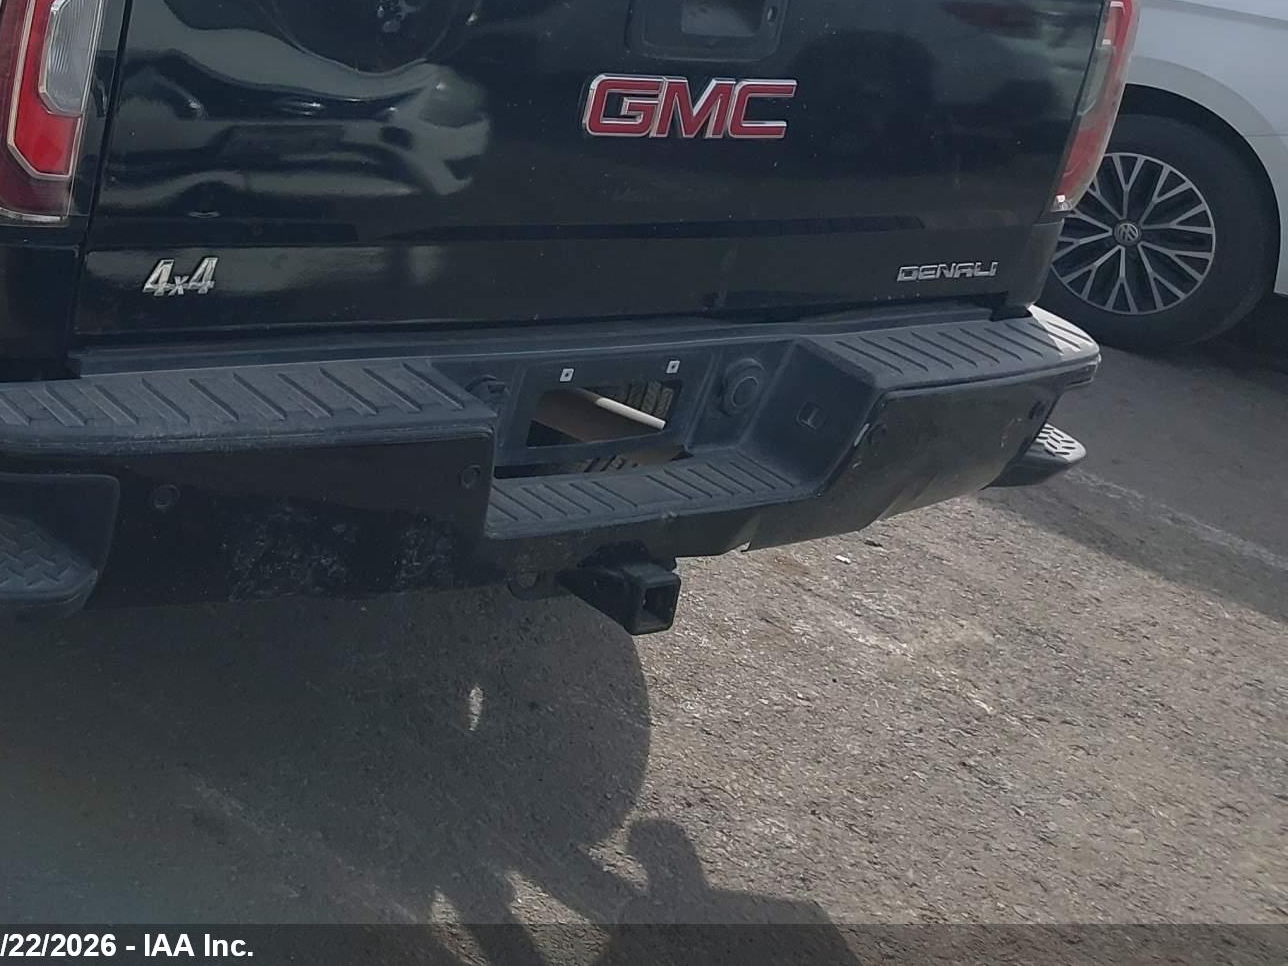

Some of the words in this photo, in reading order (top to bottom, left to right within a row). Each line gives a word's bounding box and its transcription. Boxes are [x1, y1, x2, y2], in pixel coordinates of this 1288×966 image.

[584, 74, 797, 138] GMC
[142, 257, 218, 296] 4x4
[897, 262, 998, 282] DENALI
